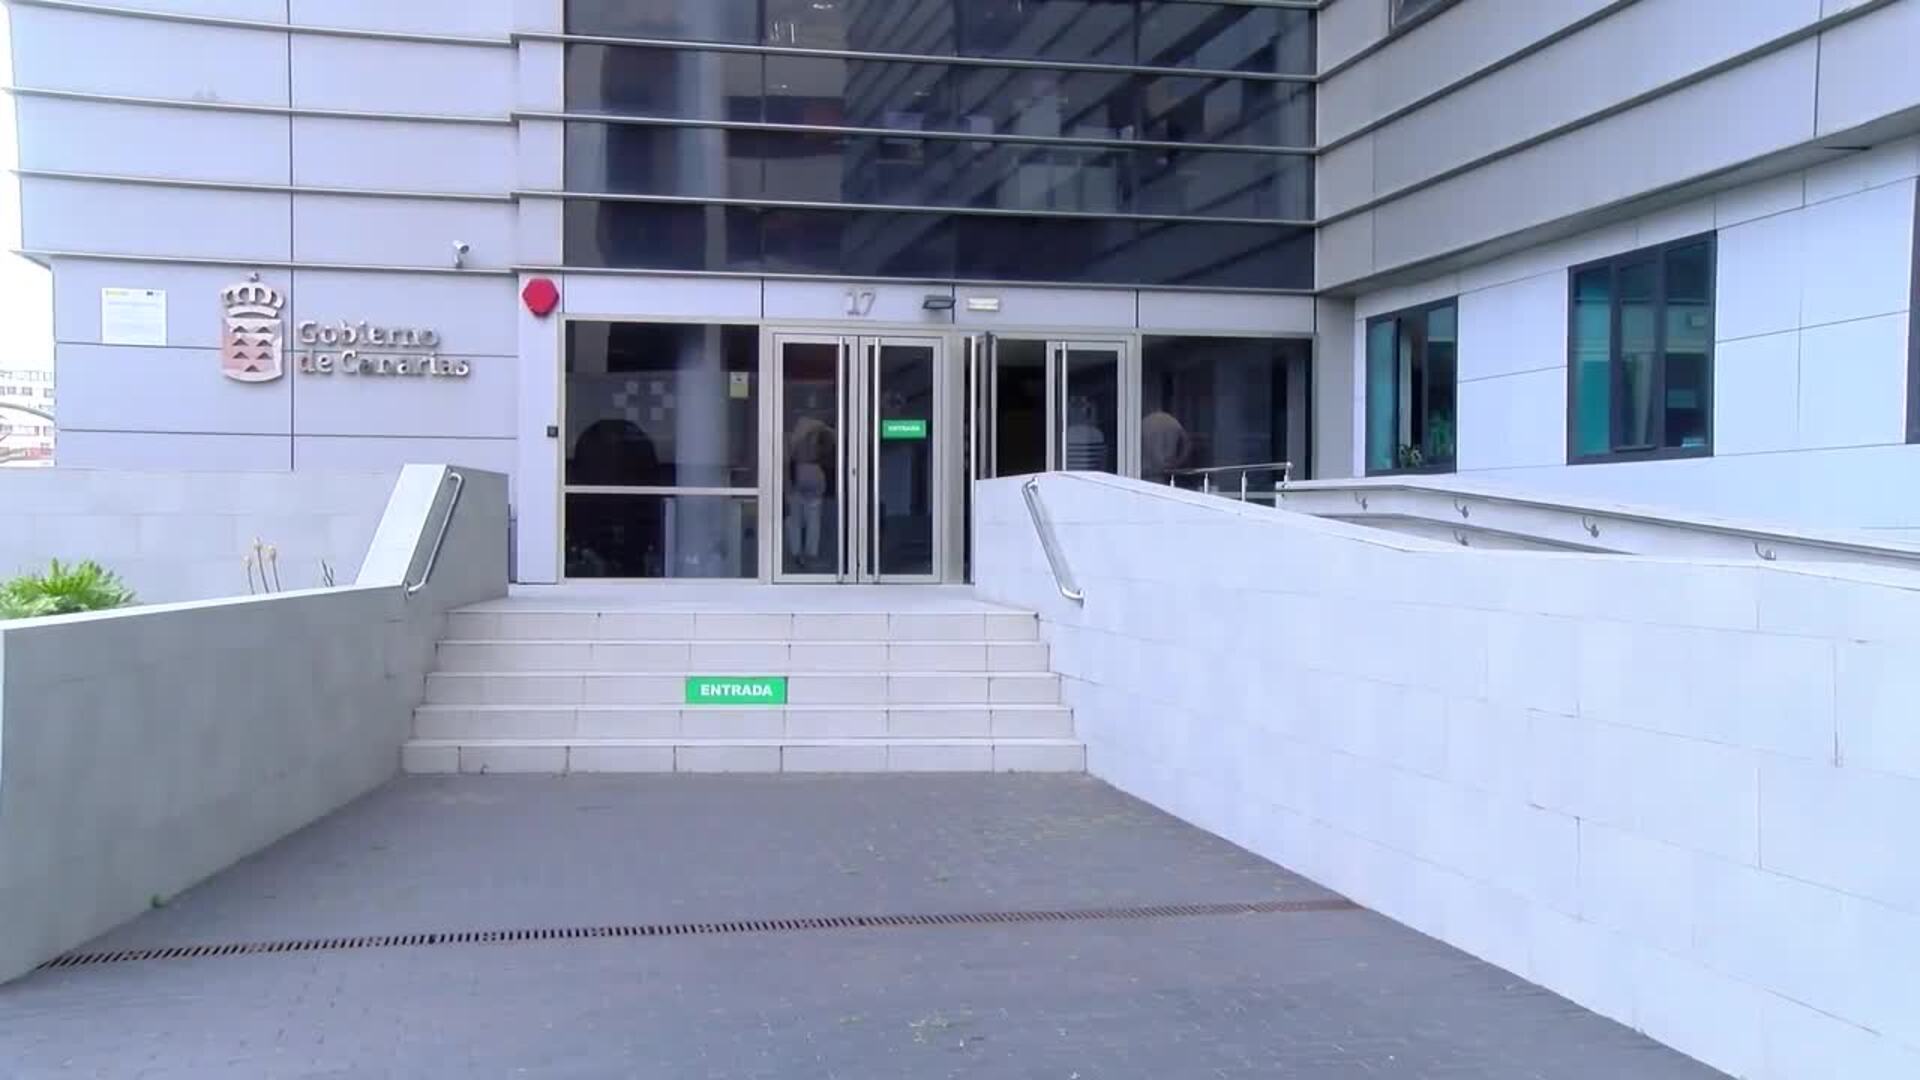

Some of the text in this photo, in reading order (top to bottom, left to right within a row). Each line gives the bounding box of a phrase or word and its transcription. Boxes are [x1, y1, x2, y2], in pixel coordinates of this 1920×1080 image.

[845, 290, 877, 316] 17
[299, 319, 440, 348] Gobierno
[300, 350, 470, 377] de Canarias
[700, 683, 774, 698] ENTRADA
